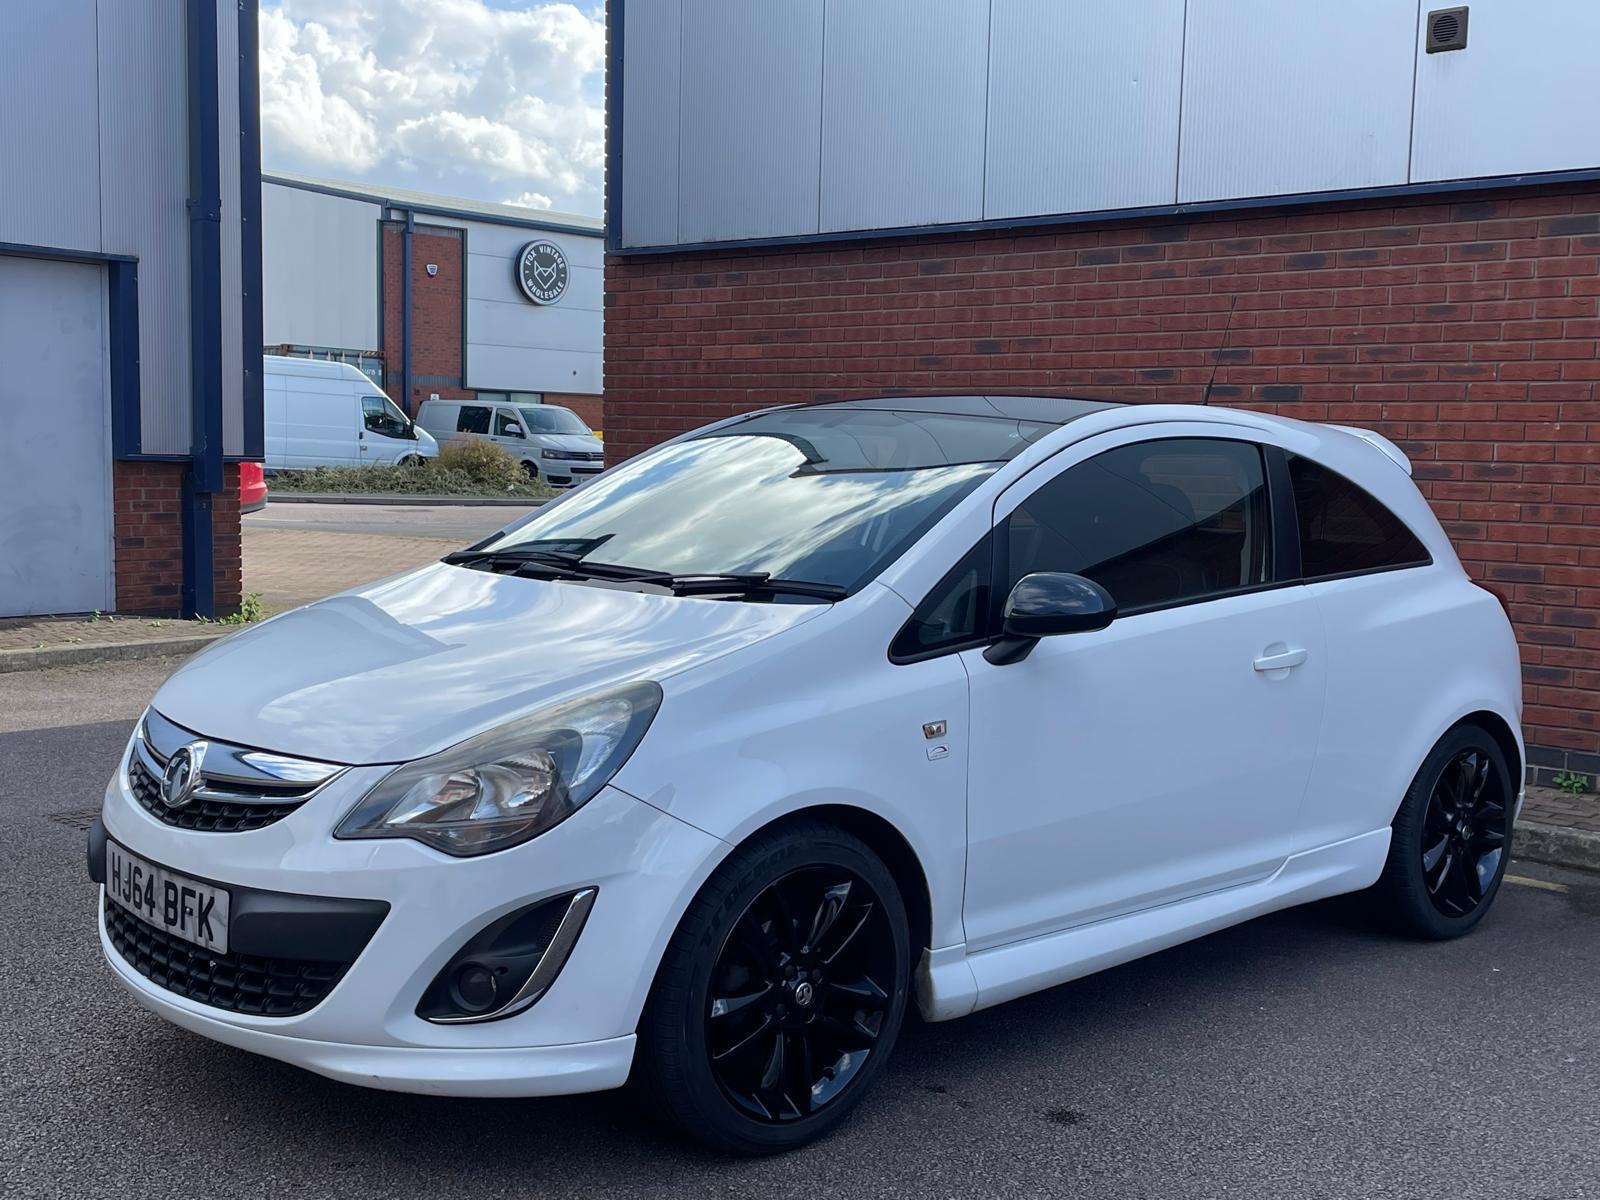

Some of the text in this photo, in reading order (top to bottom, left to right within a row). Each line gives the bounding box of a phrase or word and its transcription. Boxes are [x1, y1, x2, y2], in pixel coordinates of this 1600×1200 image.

[525, 245, 565, 269] FOX VINTAGE
[526, 278, 565, 299] WHOLESALE
[112, 851, 215, 942] HJ64 BFK
